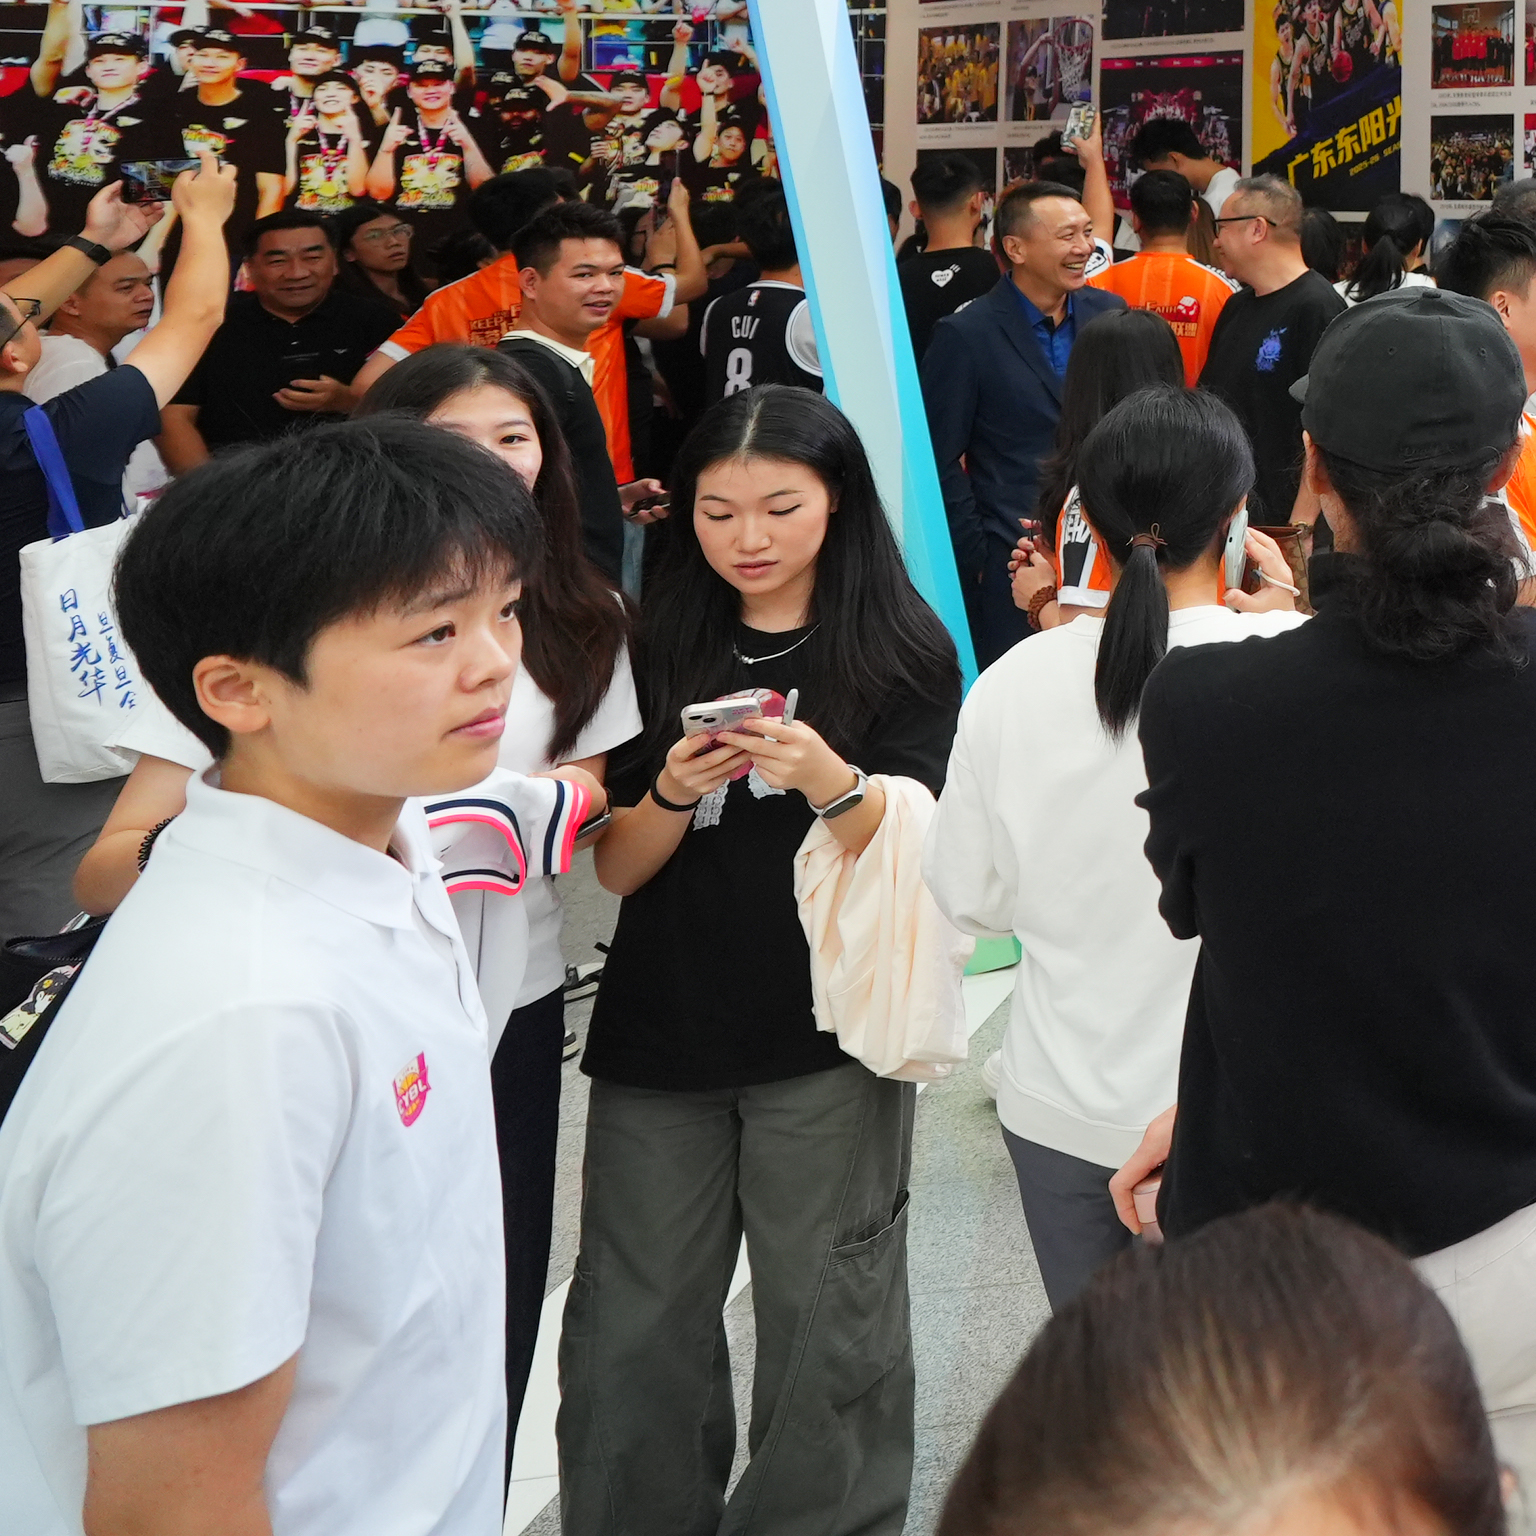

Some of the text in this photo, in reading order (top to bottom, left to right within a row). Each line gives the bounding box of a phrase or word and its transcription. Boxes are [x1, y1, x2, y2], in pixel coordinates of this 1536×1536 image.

[470, 318, 504, 330] KEEP
[731, 315, 760, 340] CUI
[724, 347, 753, 398] 8
[60, 588, 107, 707] 日月光华
